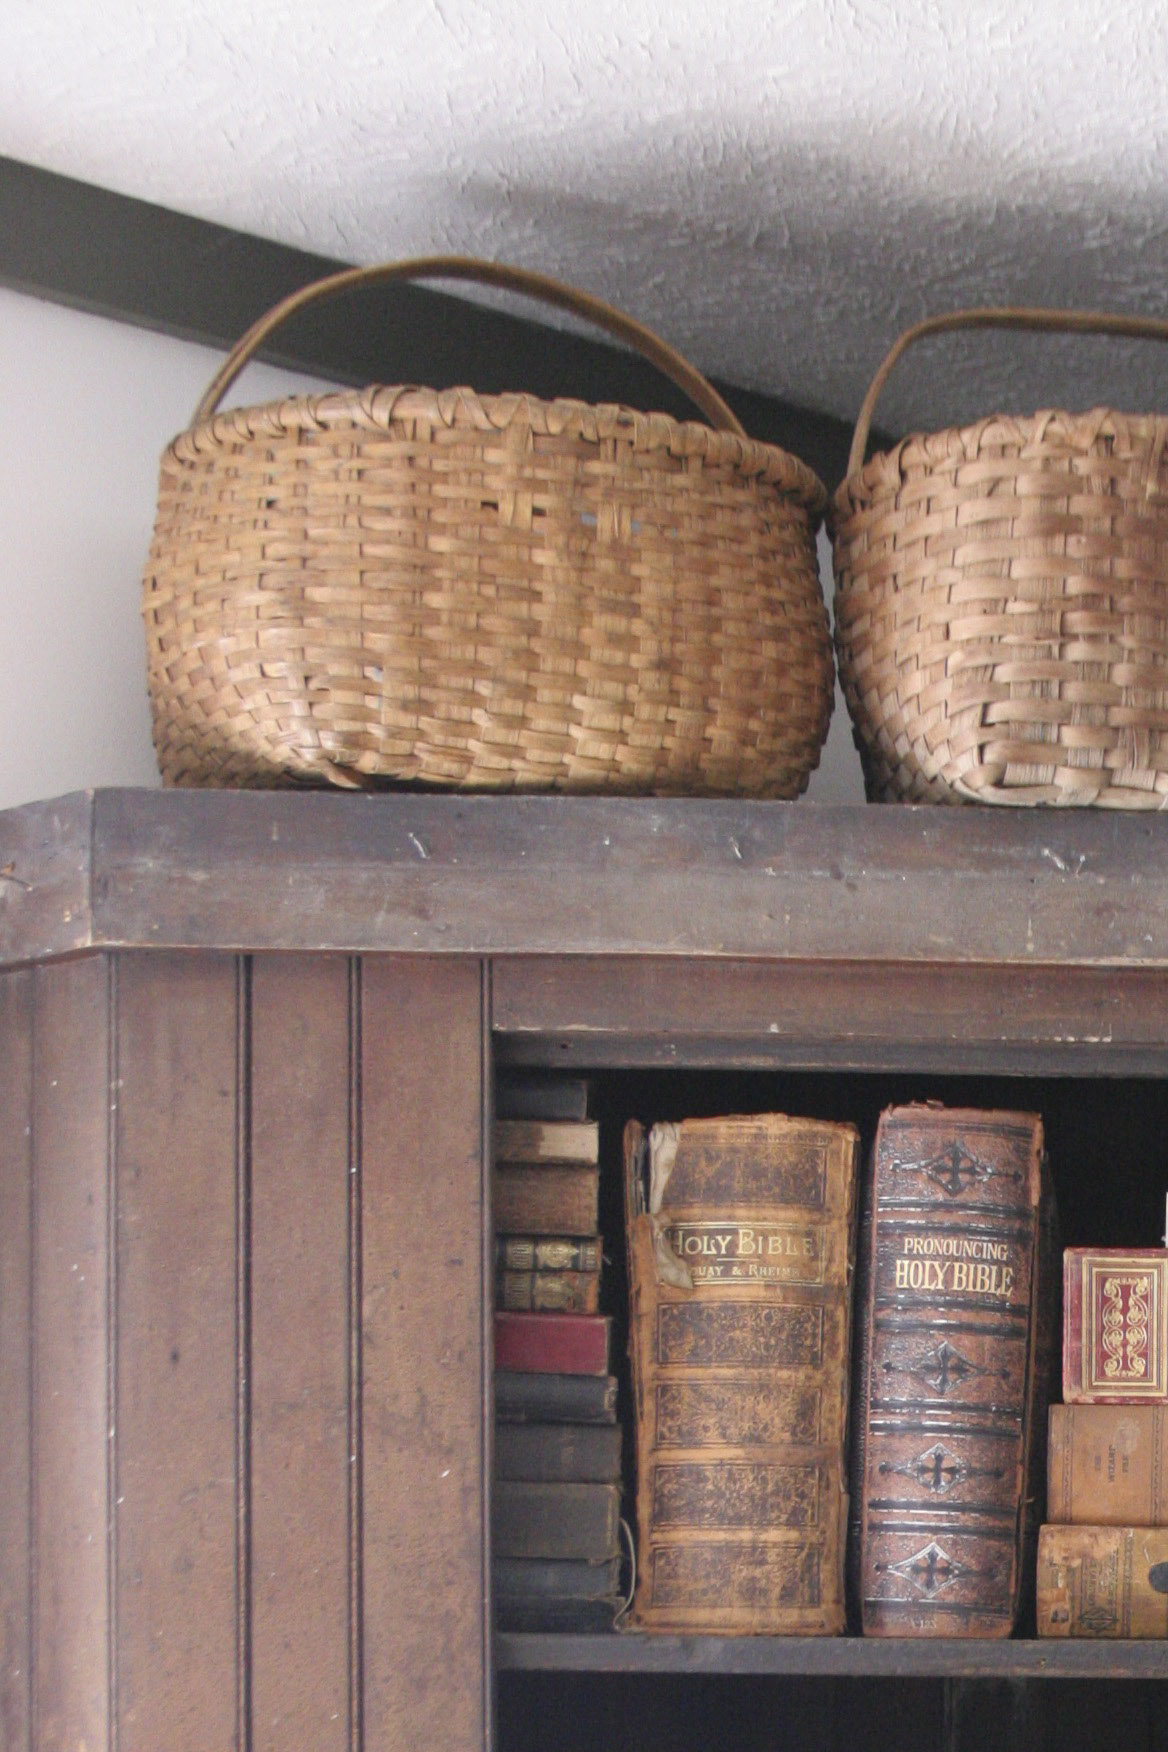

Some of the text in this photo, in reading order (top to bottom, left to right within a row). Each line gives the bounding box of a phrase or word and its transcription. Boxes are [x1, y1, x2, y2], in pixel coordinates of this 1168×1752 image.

[737, 1229, 814, 1256] BIBLE
[903, 1237, 1009, 1261] PRONOUNCING
[732, 1266, 743, 1277] &
[895, 1259, 1014, 1297] HOLY BIBLE
